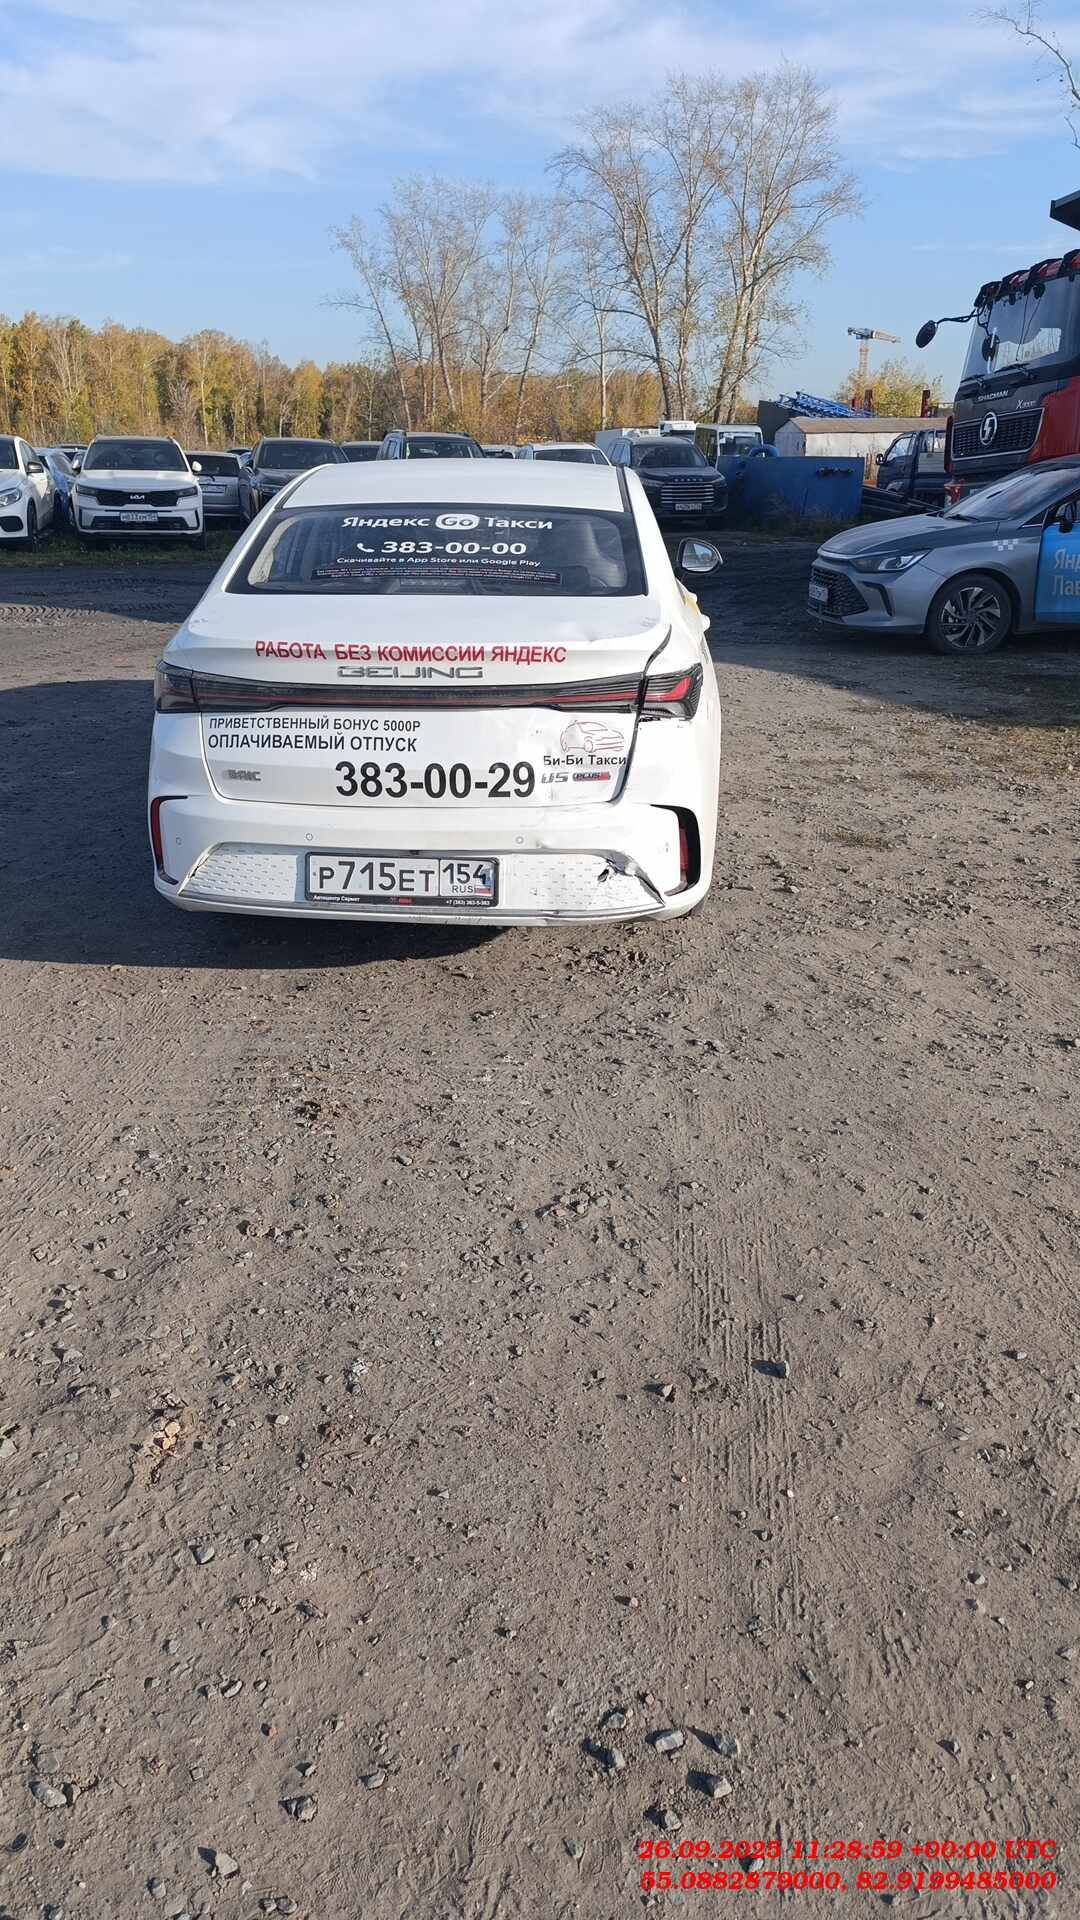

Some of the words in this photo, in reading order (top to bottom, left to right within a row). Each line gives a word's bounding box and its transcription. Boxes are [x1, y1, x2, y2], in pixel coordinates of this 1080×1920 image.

[341, 516, 431, 528] Яндекс
[484, 516, 553, 530] Такси
[381, 541, 527, 555] 383-00-00
[336, 557, 396, 565] Скачивайте
[407, 557, 429, 565] App
[481, 557, 517, 566] Google
[519, 559, 540, 568] Play
[255, 640, 327, 660] РАБОТА
[334, 643, 371, 661] БЕЗ
[378, 645, 485, 662] КОМИССИИ
[491, 645, 567, 665] ЯНДЕКС
[337, 666, 483, 679] BEIJING
[209, 715, 329, 730] ПРИВЕТСТВЕННЫЙ
[333, 718, 379, 731] БОНУС
[208, 732, 345, 750] ОПЛАЧИВАЕМЫЙ
[350, 736, 417, 752] ОТПУСК
[543, 755, 583, 765] Би-Би
[587, 754, 626, 765] Такси
[335, 761, 535, 799] 383-00-29
[319, 861, 435, 892] Р715ЕТ
[442, 863, 486, 886] 154
[451, 885, 474, 893] RUS
